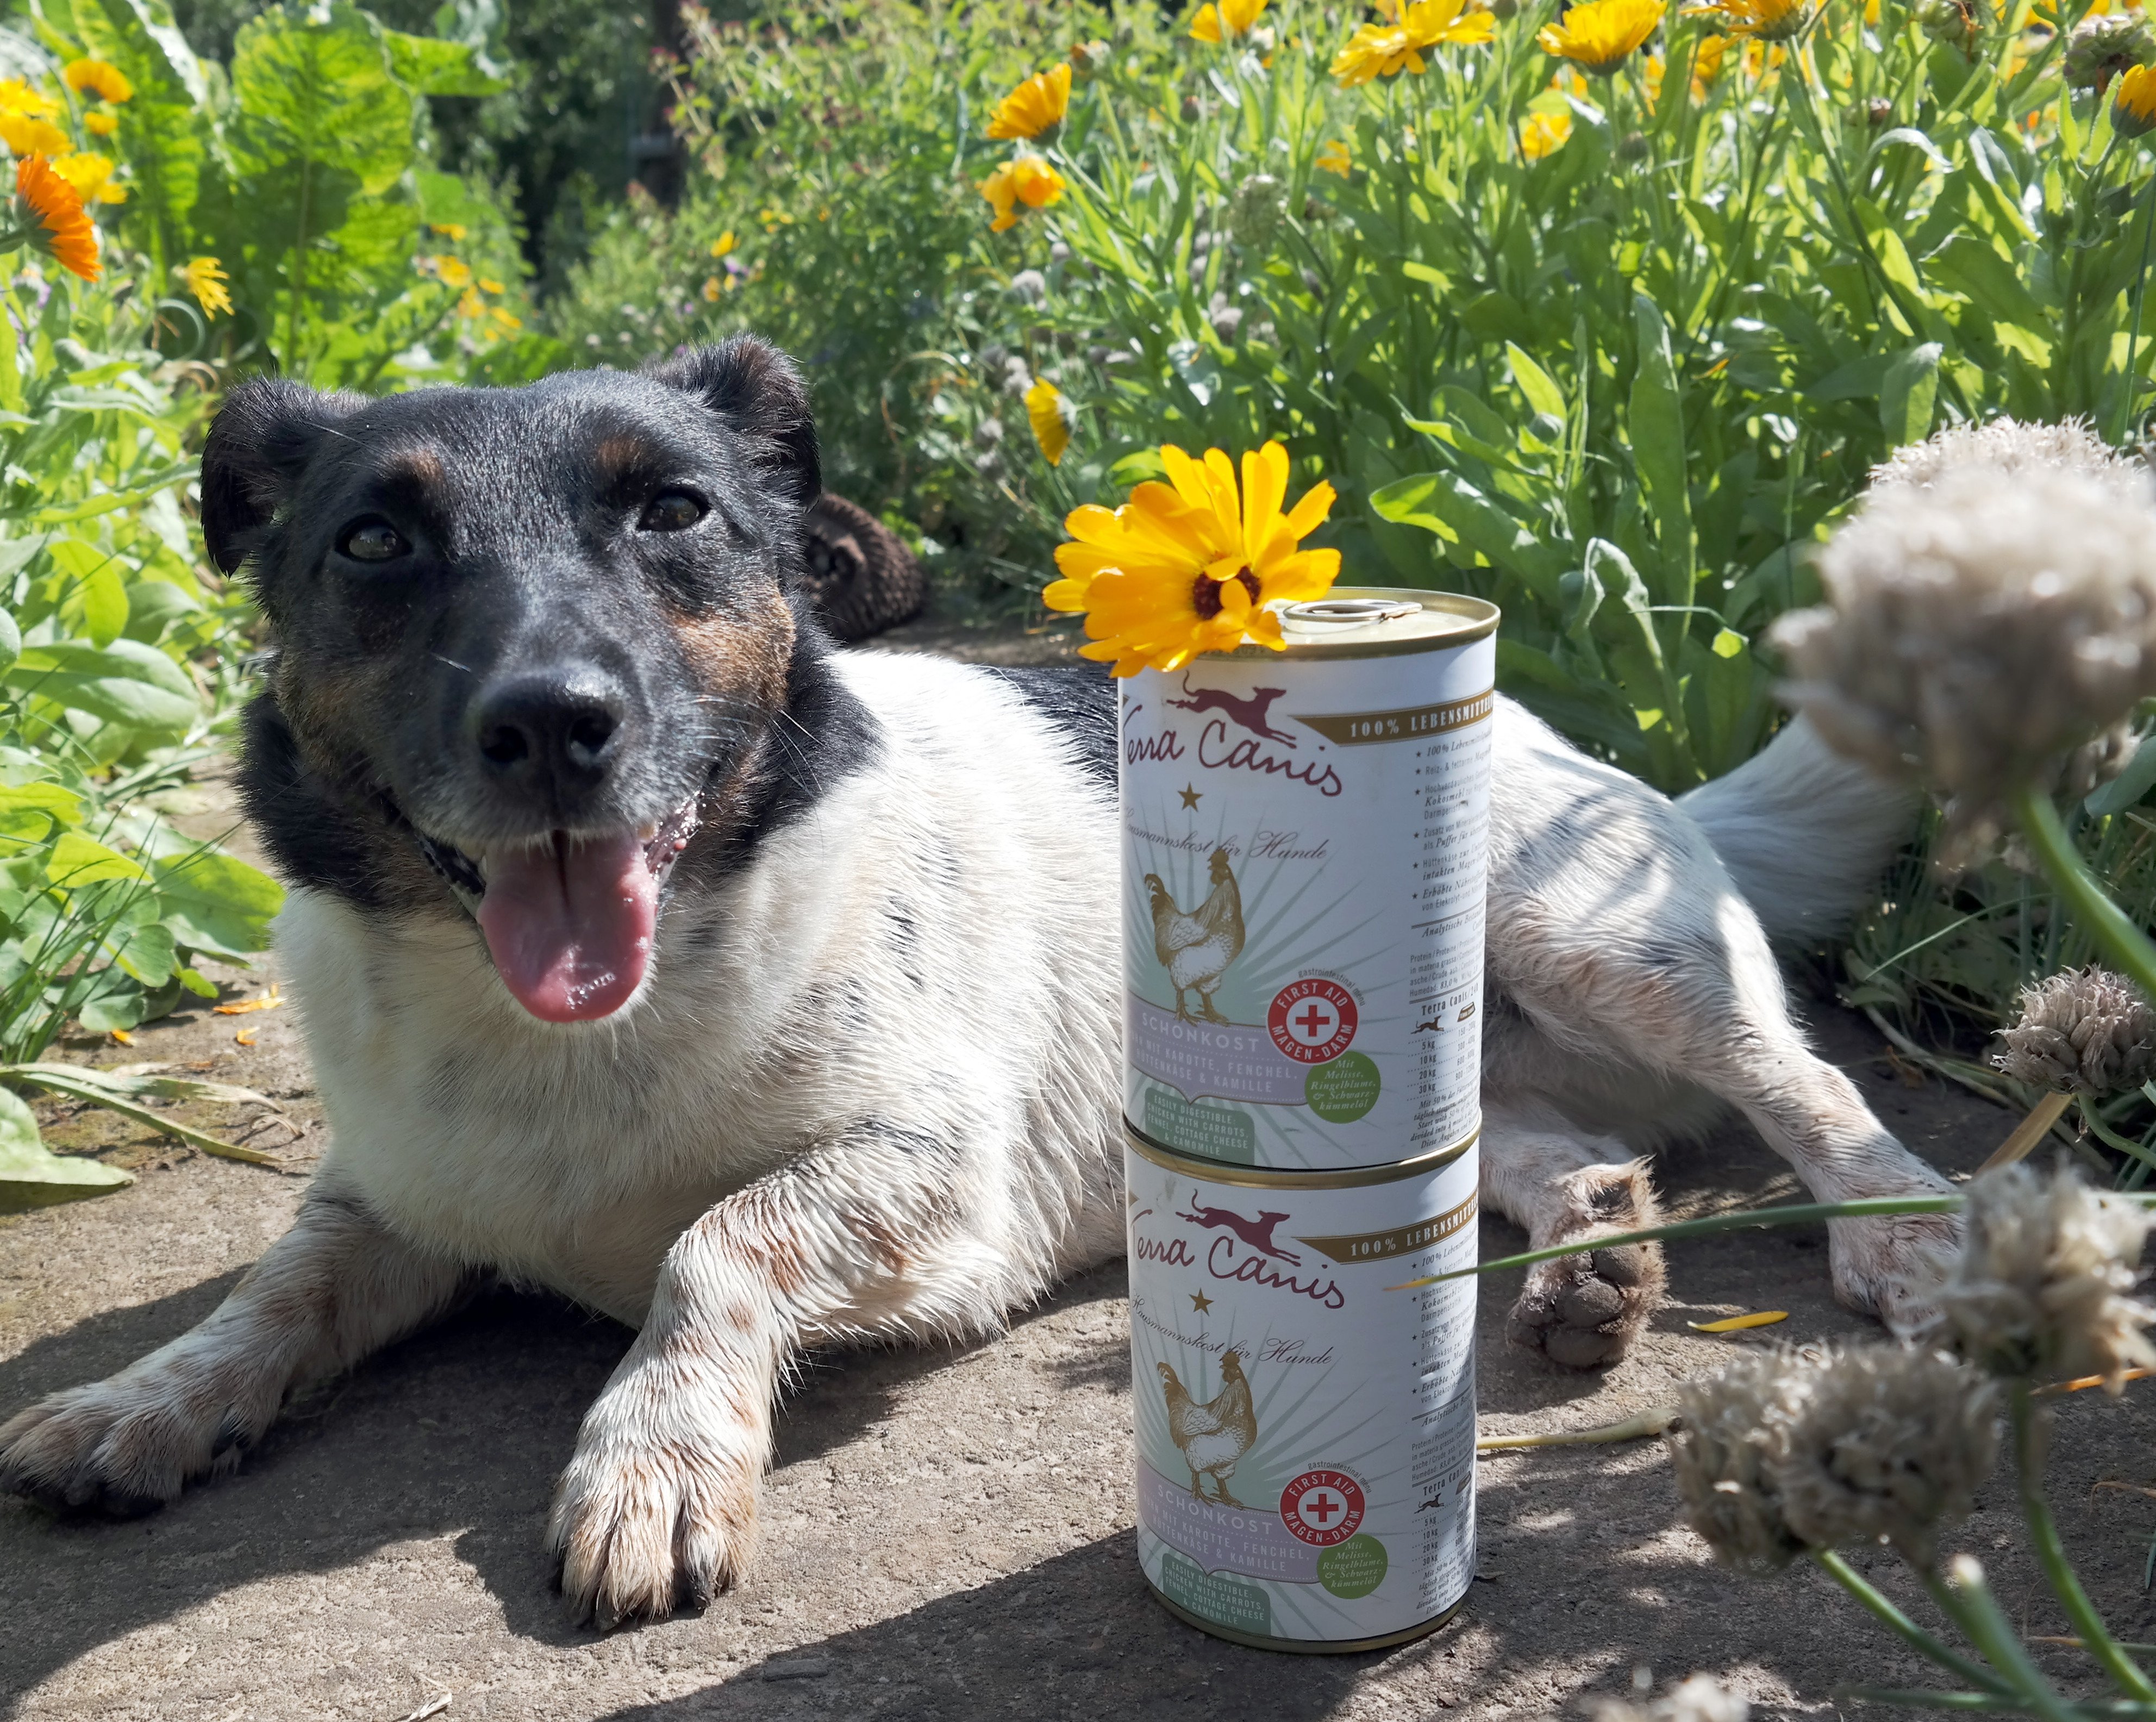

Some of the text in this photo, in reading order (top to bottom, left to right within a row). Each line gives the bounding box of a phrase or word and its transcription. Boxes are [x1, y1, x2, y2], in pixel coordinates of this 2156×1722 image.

[1351, 719, 1399, 737] 100%
[1198, 719, 1342, 796] Canis
[1248, 830, 1329, 859] Hunde
[1298, 968, 1355, 989] gastrointestinal
[1277, 982, 1348, 1009] FIRST AID
[1421, 1001, 1446, 1015] Terra
[1142, 1012, 1259, 1052] SCHONKOST
[1272, 1024, 1353, 1060] MAGEN-DARM
[1335, 1060, 1354, 1069] Mit
[1147, 1102, 1174, 1121] CHICKEN
[1178, 1115, 1198, 1128] WITH
[1154, 1095, 1177, 1112] EASILY
[1173, 1135, 1221, 1156] CAMOMILE
[1174, 1125, 1209, 1142] COTTAGE
[1213, 1135, 1248, 1150] CHEESE
[1350, 1237, 1396, 1257] 100%
[1208, 1236, 1345, 1309] Canis
[1258, 1338, 1334, 1364] Hunde
[1288, 1474, 1355, 1497] FIRST AID
[1308, 1461, 1372, 1494] gastrointestinal menu
[1423, 1478, 1445, 1496] Terra
[1158, 1484, 1272, 1535] SCHONKOST
[1284, 1510, 1361, 1543] MAGEN-DARM
[1345, 1542, 1363, 1550] Mit
[1230, 1552, 1286, 1571] KAMILLE
[1165, 1567, 1265, 1612] CHICKEN WITH CARROTS,
[1172, 1562, 1252, 1599] EASILY DIGESTIBLE:
[1165, 1576, 1265, 1621] FENNEL, COTTAGE CHEESE
[1192, 1601, 1238, 1625] CAMOMILE
